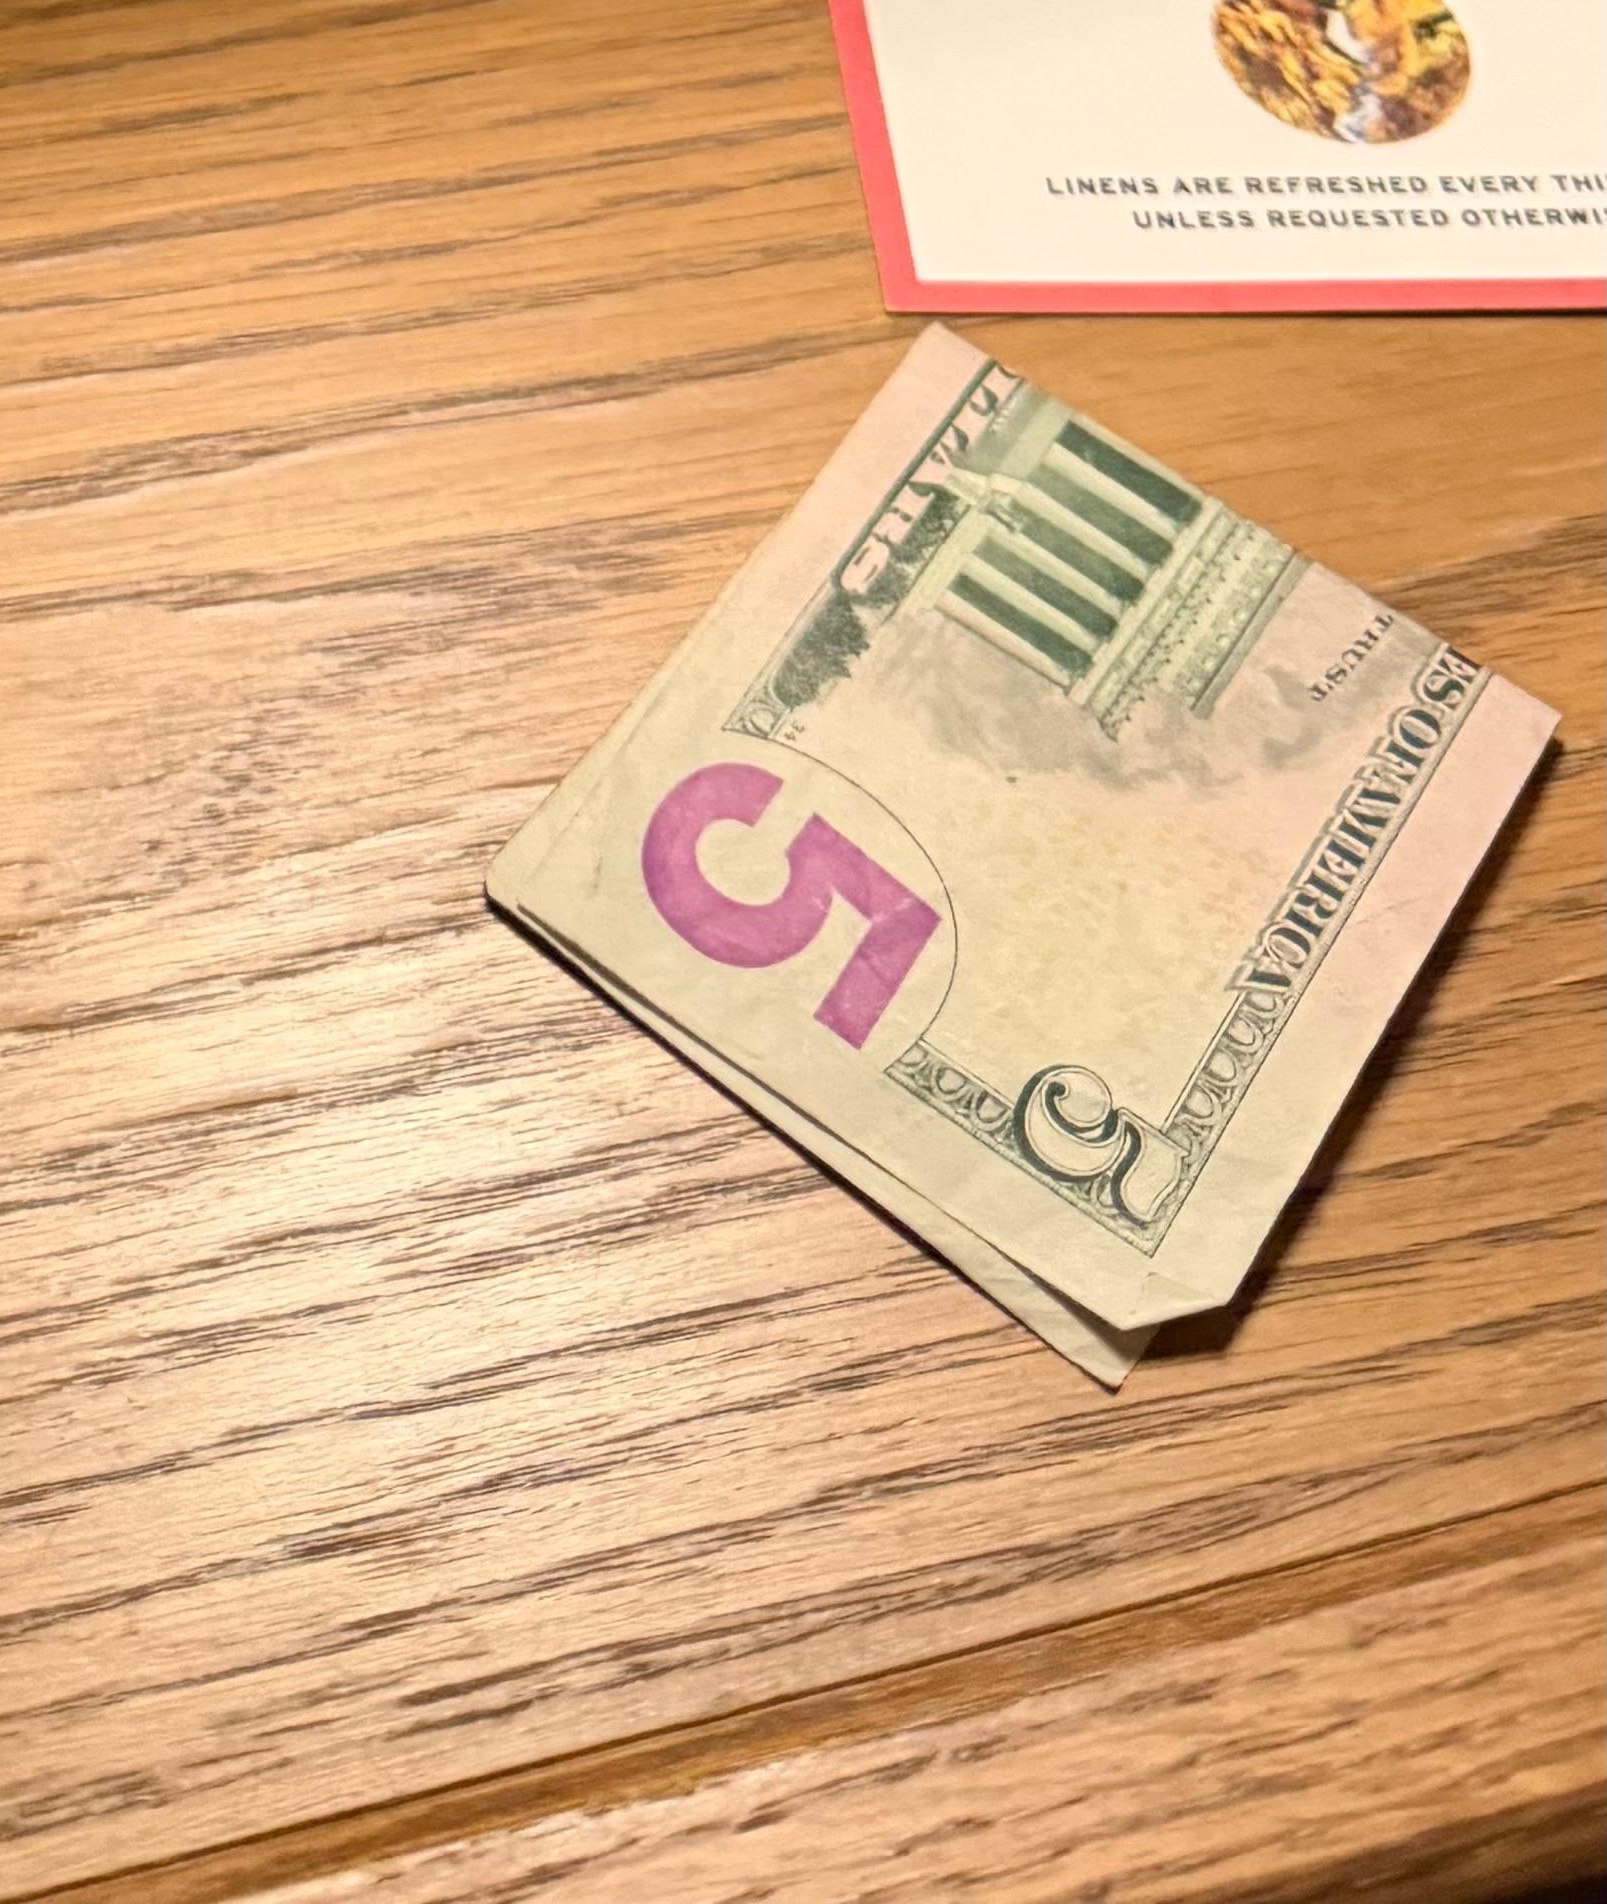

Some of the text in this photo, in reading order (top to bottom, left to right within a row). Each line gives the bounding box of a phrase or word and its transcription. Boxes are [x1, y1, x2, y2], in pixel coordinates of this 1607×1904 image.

[1045, 174, 1607, 196] LINENS ARE REFRESHED EVERY THI
[1132, 207, 1607, 230] UNLESS REQUESTED OTHERWI
[840, 366, 1026, 595] LLARS
[1308, 613, 1394, 702] TRUST
[1383, 707, 1443, 785] OF
[640, 761, 942, 1050] 5
[1244, 778, 1403, 991] AMERICA
[1013, 1063, 1191, 1230] 5
